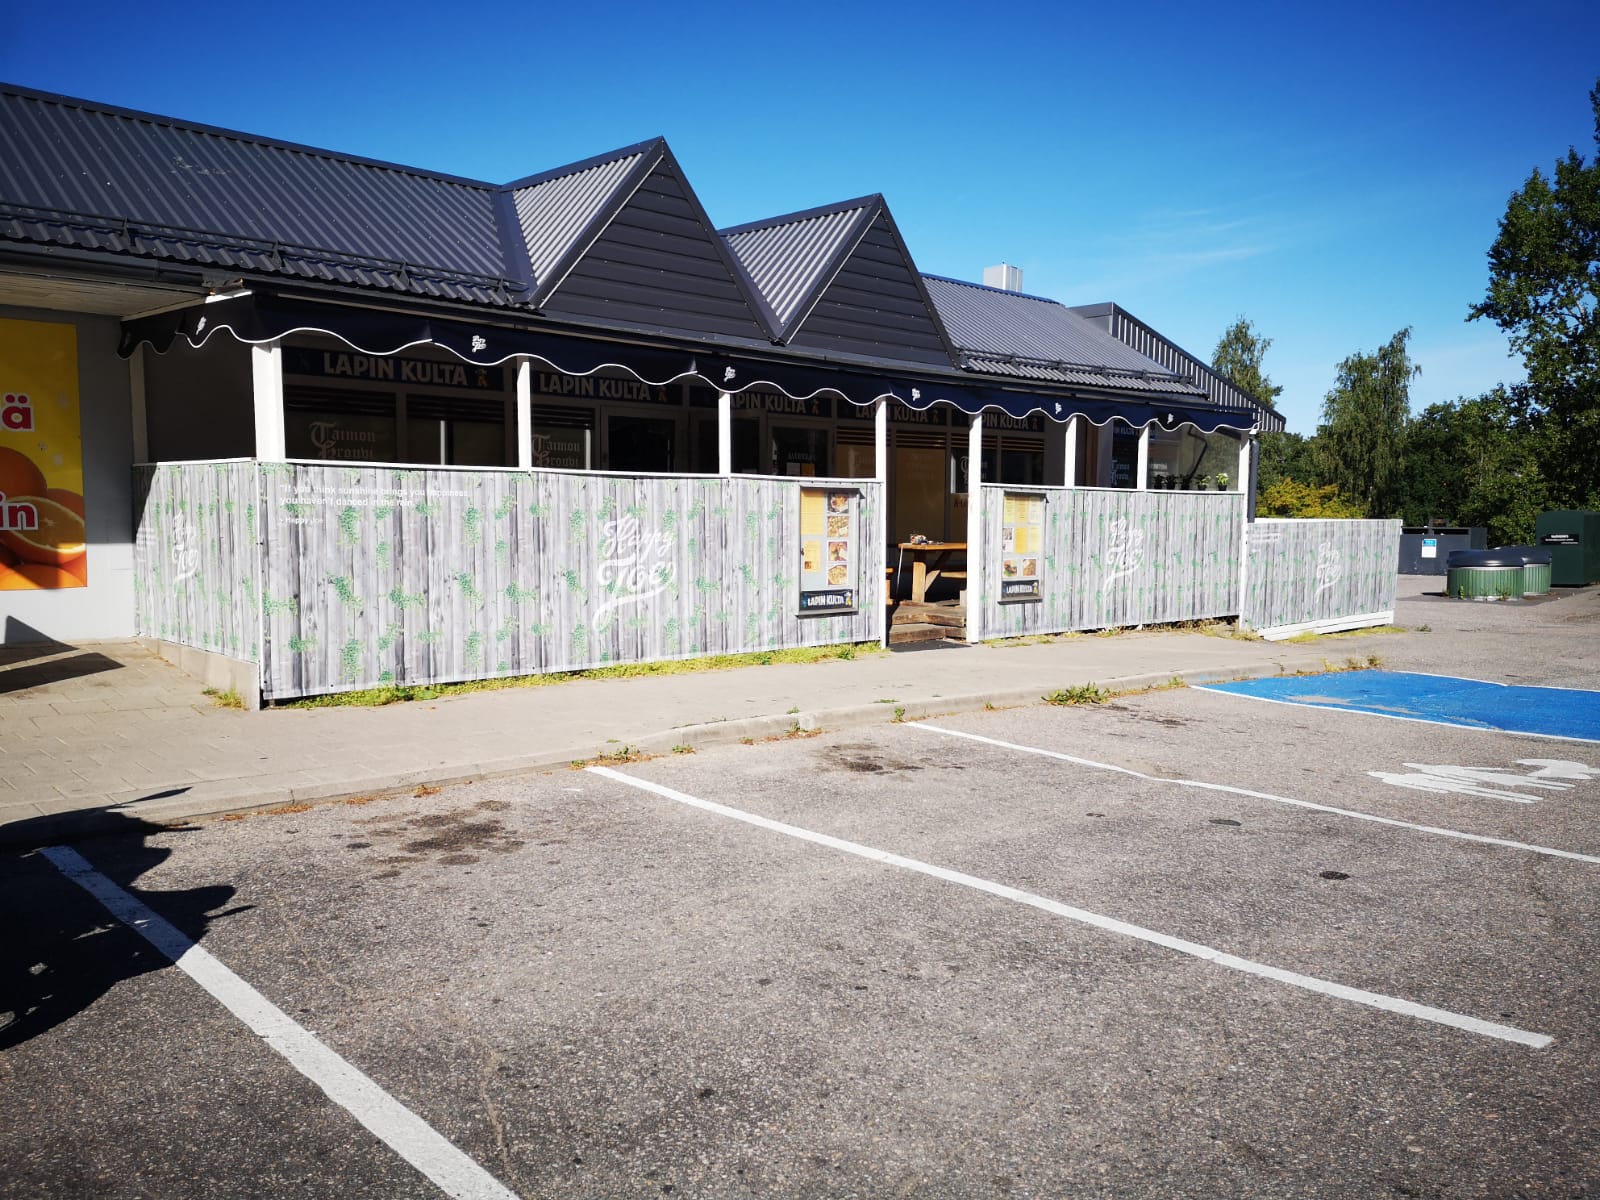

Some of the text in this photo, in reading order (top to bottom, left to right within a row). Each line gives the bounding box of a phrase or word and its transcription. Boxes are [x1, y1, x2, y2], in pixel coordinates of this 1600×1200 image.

[323, 352, 469, 387] LAPIN KULTA
[539, 373, 652, 401] LAPIN KULTA
[1, 392, 35, 431] ä
[730, 393, 807, 414] APIN KULTA
[894, 406, 928, 423] KULTA
[1000, 414, 1029, 430] KULTA
[280, 497, 298, 506] you
[336, 498, 368, 506] danced
[294, 486, 311, 494] you
[409, 490, 425, 498] you
